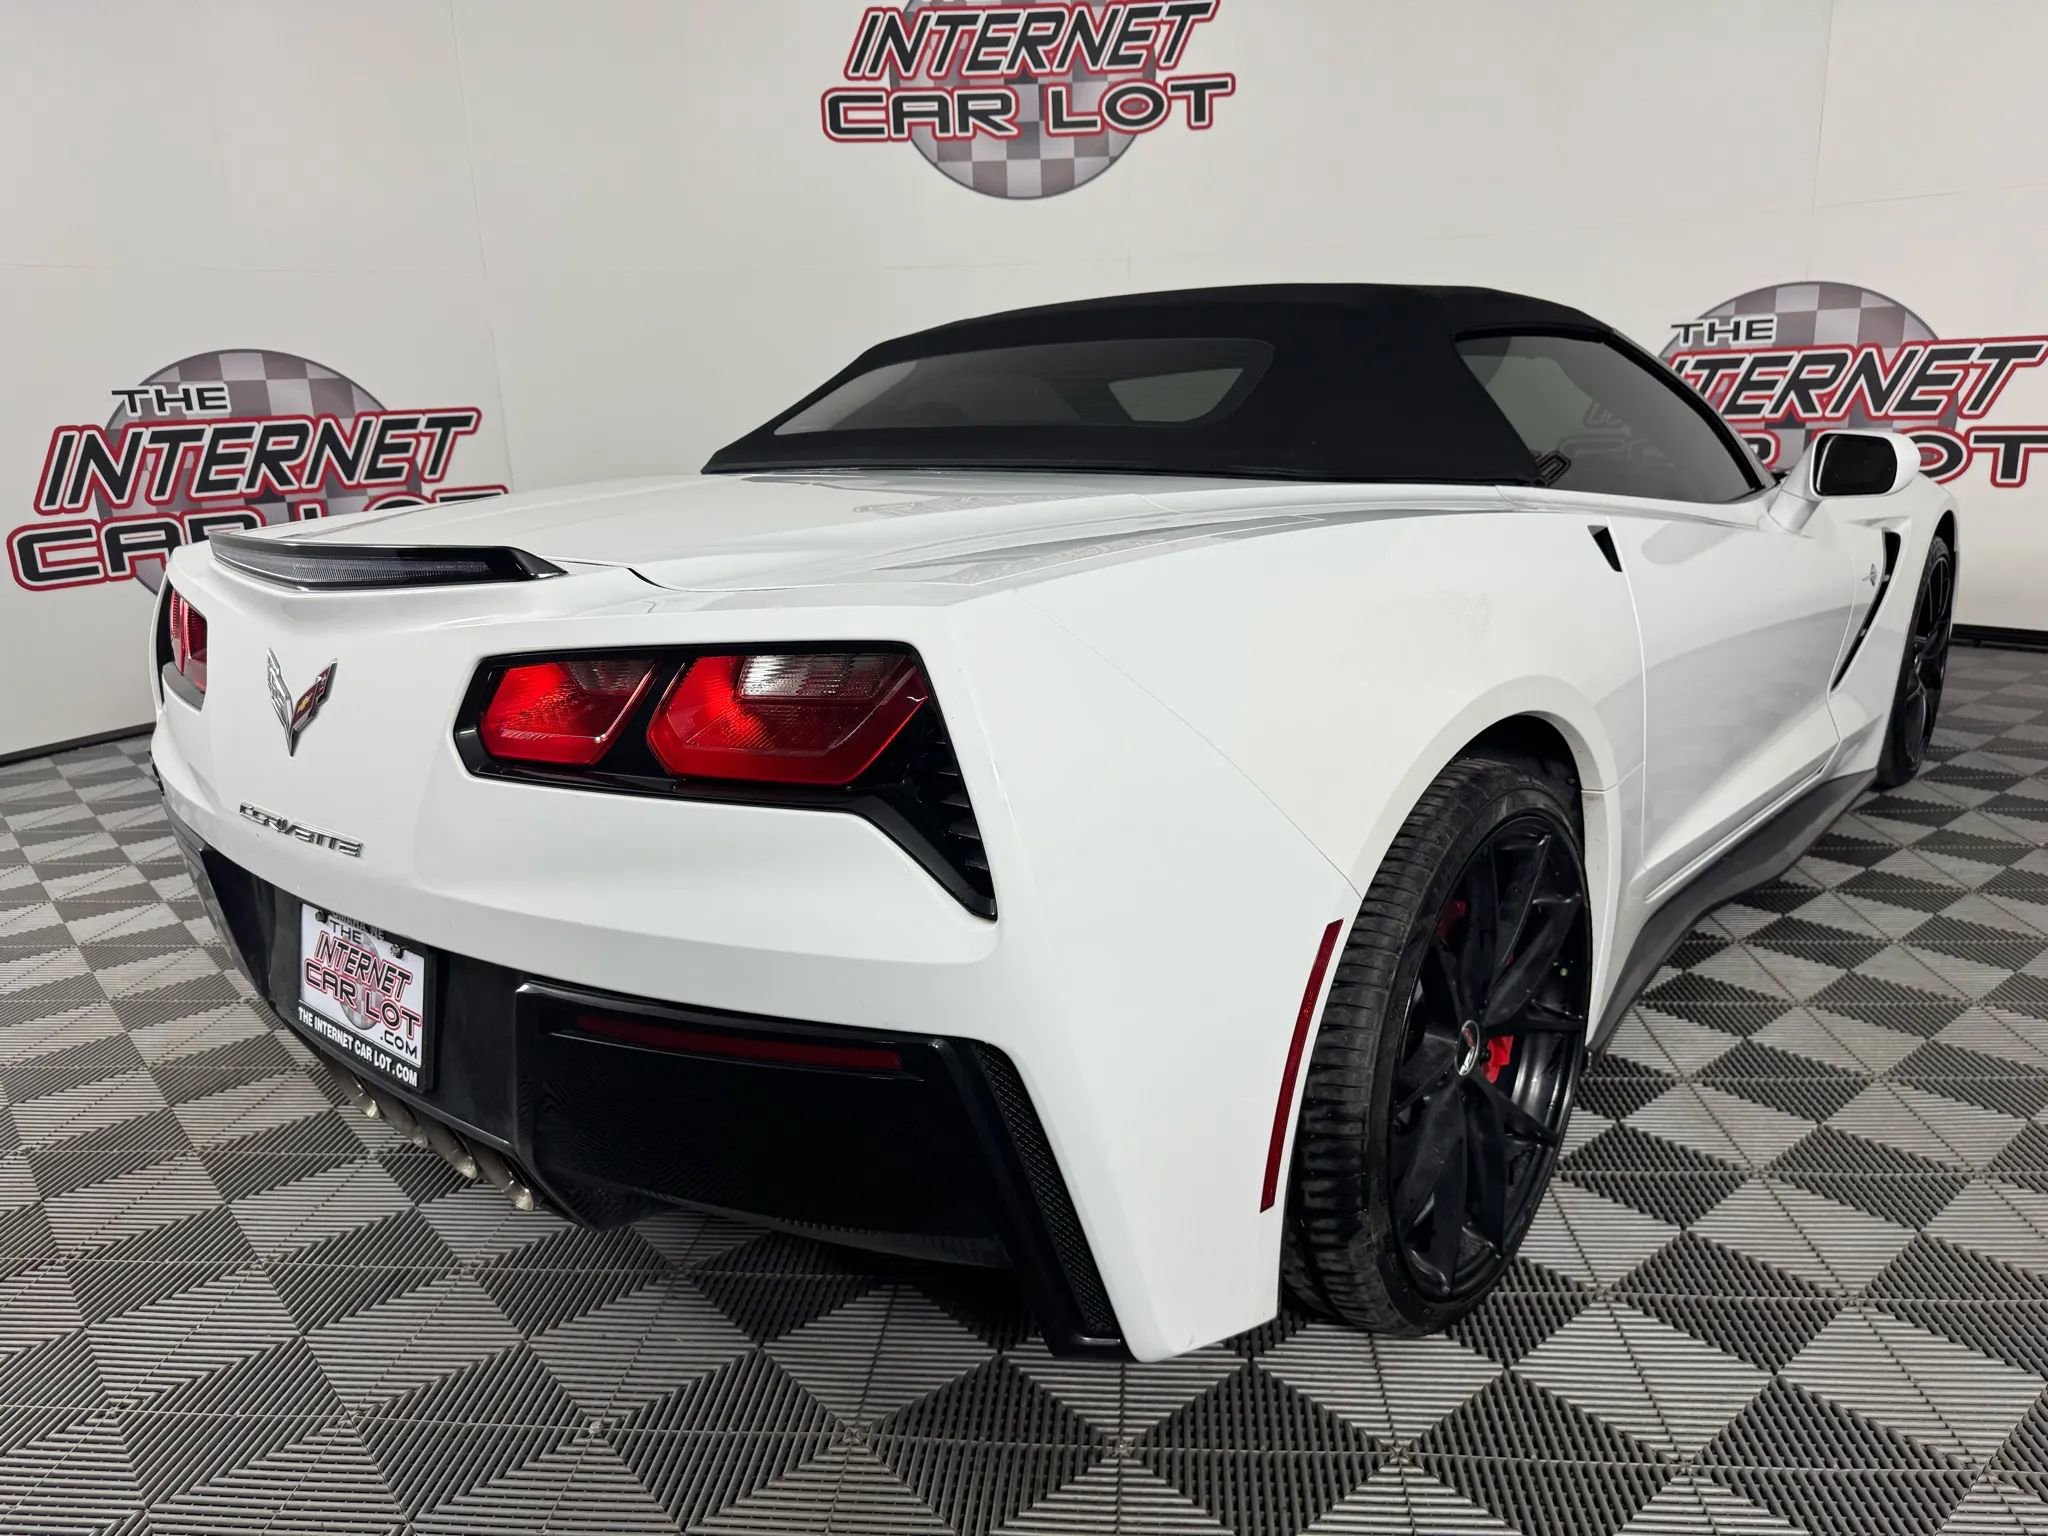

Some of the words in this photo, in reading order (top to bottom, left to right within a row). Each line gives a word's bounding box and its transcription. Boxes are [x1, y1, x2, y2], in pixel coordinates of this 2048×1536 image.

[846, 0, 1216, 77] INTERNET
[824, 88, 1018, 139] CAR
[1047, 77, 1233, 133] LOT
[1671, 318, 1776, 343] THE
[111, 385, 230, 415] THE
[1672, 339, 2047, 418] TERNET
[39, 410, 479, 511] INTERNET
[240, 802, 362, 857] CORVETTE
[330, 919, 361, 945] THE
[315, 931, 413, 999] INTERNET
[305, 959, 357, 1008] CAR
[365, 989, 422, 1039] LOT
[299, 1007, 314, 1028] THE
[314, 1016, 353, 1050] INTERNET
[354, 1039, 372, 1062] CAR
[380, 1030, 418, 1060] .COM
